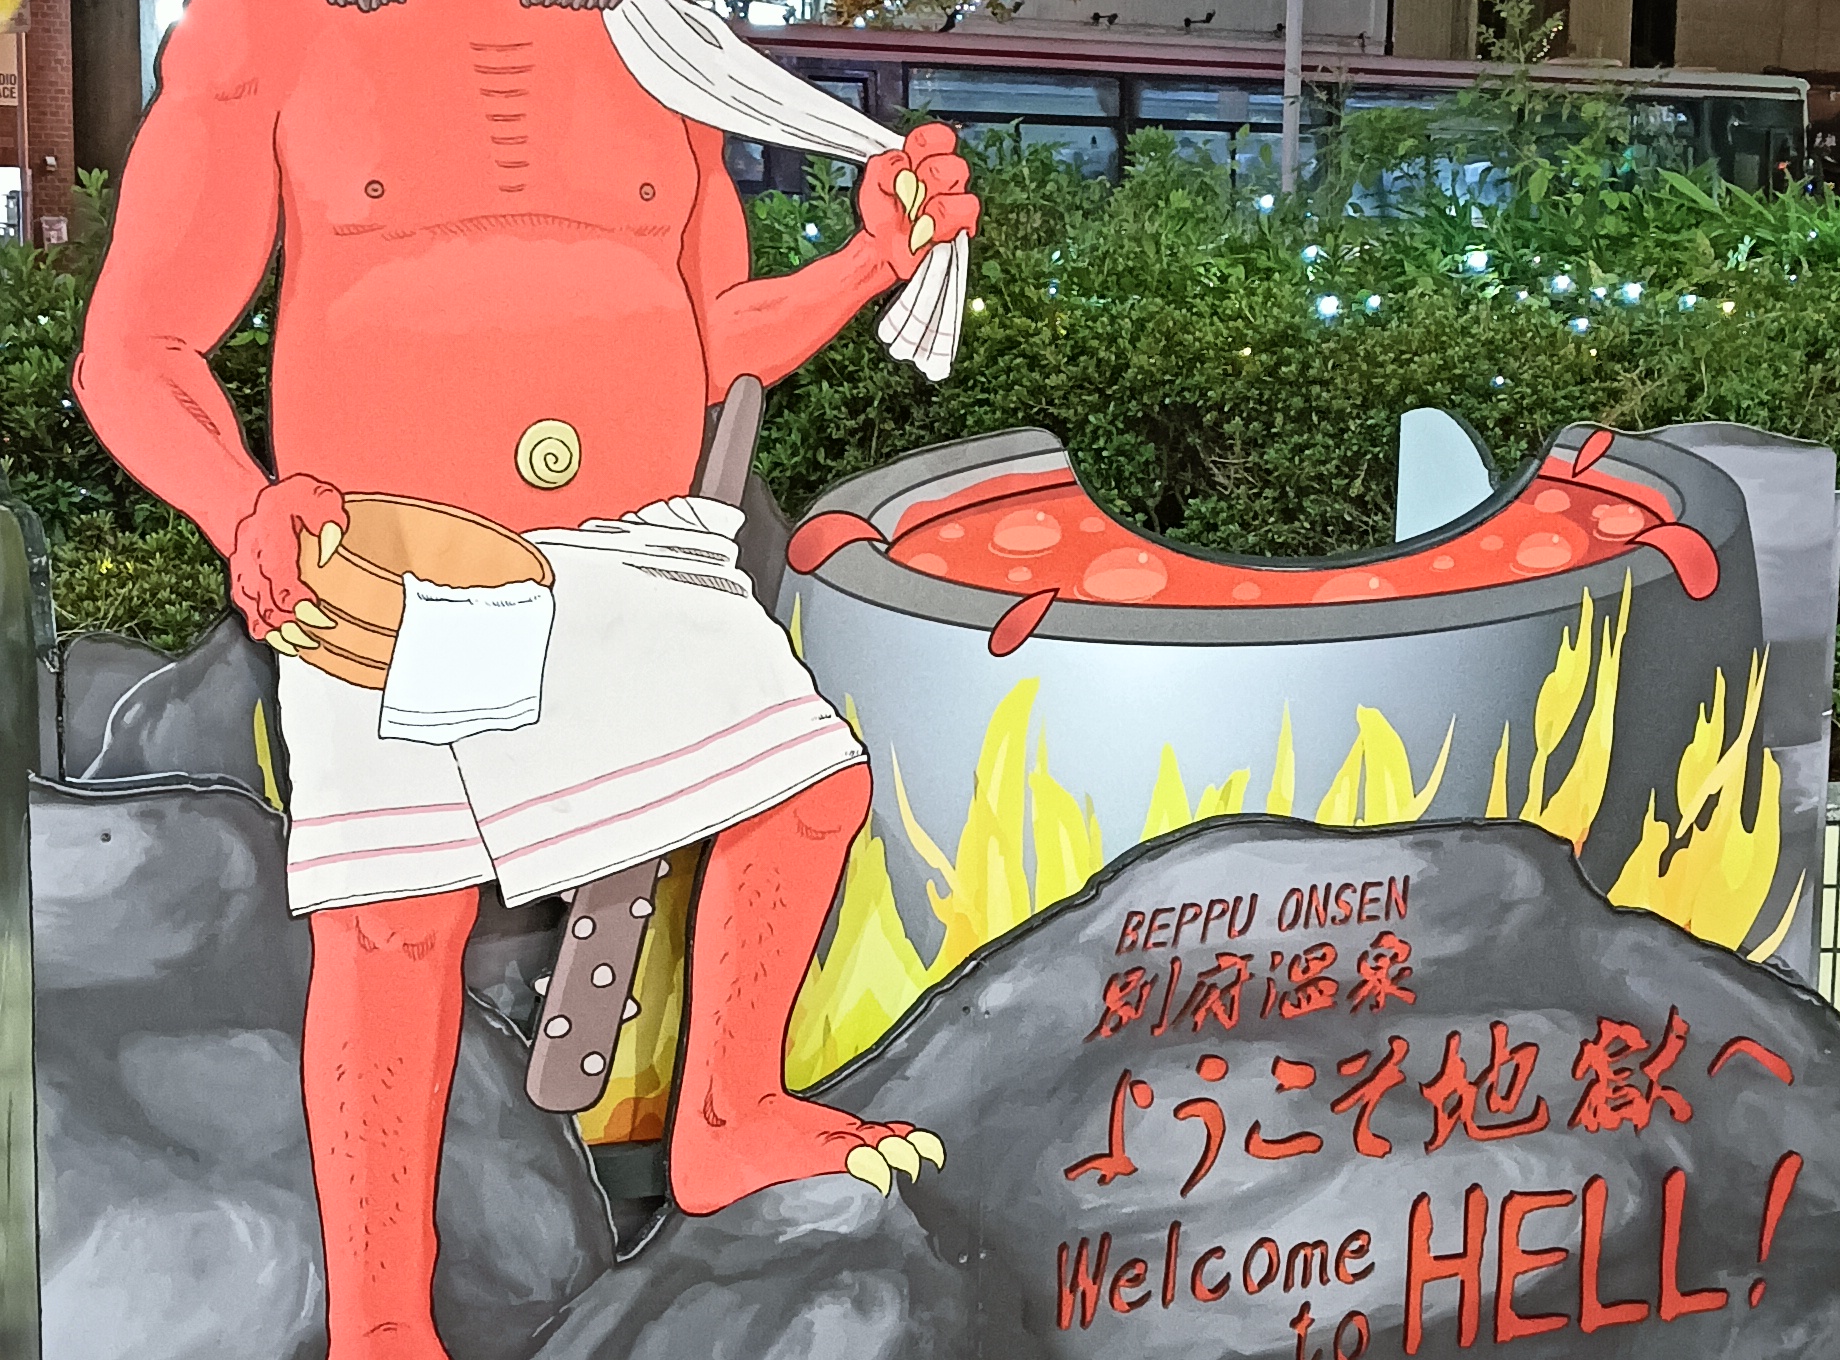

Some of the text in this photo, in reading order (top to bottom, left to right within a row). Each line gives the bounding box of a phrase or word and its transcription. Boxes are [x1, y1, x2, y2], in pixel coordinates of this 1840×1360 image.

[0, 87, 17, 99] CE
[1115, 874, 1411, 956] BEPPU ONSEN
[1083, 930, 1417, 1043] 別府温泉
[1064, 1006, 1795, 1198] ようこそ地獄へ
[1056, 1220, 1376, 1331] Welcome
[1403, 1150, 1803, 1356] HELL!
